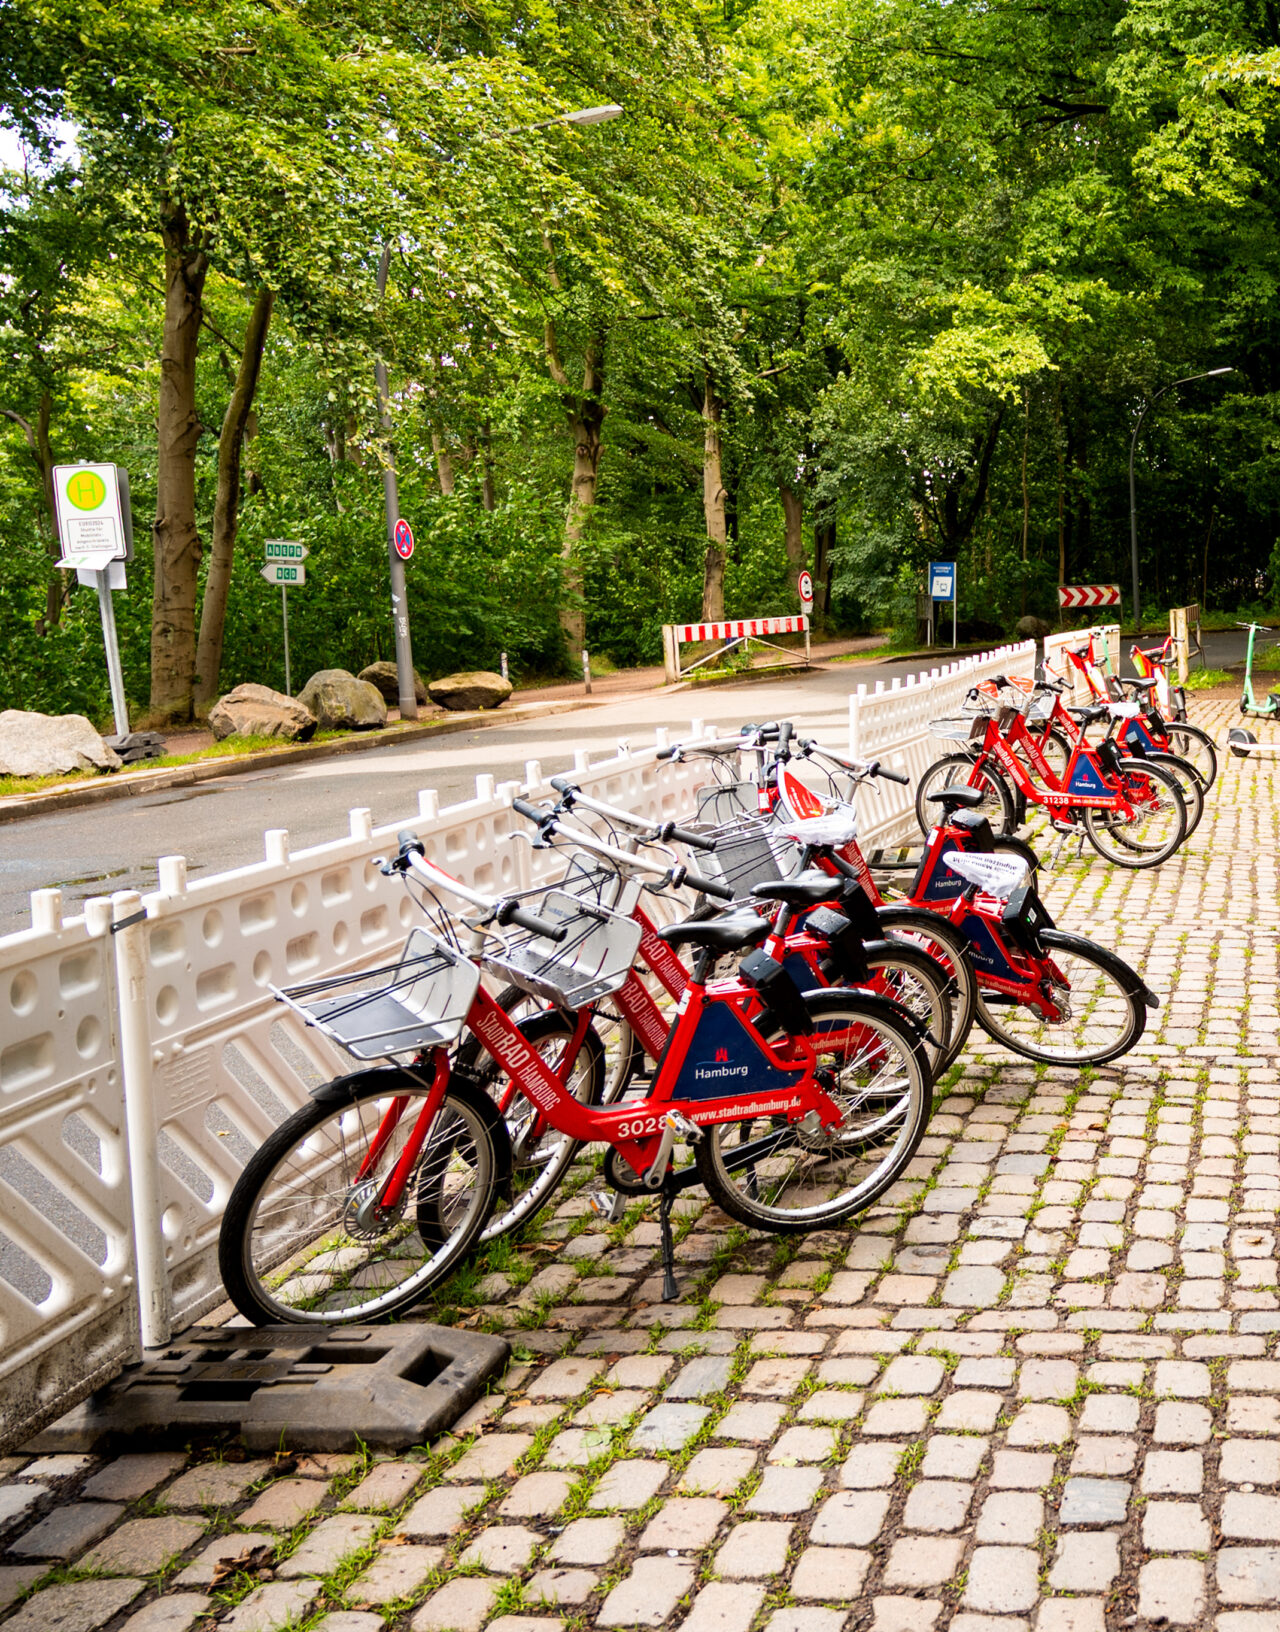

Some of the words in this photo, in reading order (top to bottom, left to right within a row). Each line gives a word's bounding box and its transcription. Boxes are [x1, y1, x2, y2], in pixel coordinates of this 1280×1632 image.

[1075, 781, 1096, 789] Hamburg
[1043, 796, 1069, 805] 31238
[695, 1064, 749, 1080] Hamburg
[516, 1060, 561, 1112] HAMBURG
[691, 1095, 802, 1122] www.stadtradhamburg.de
